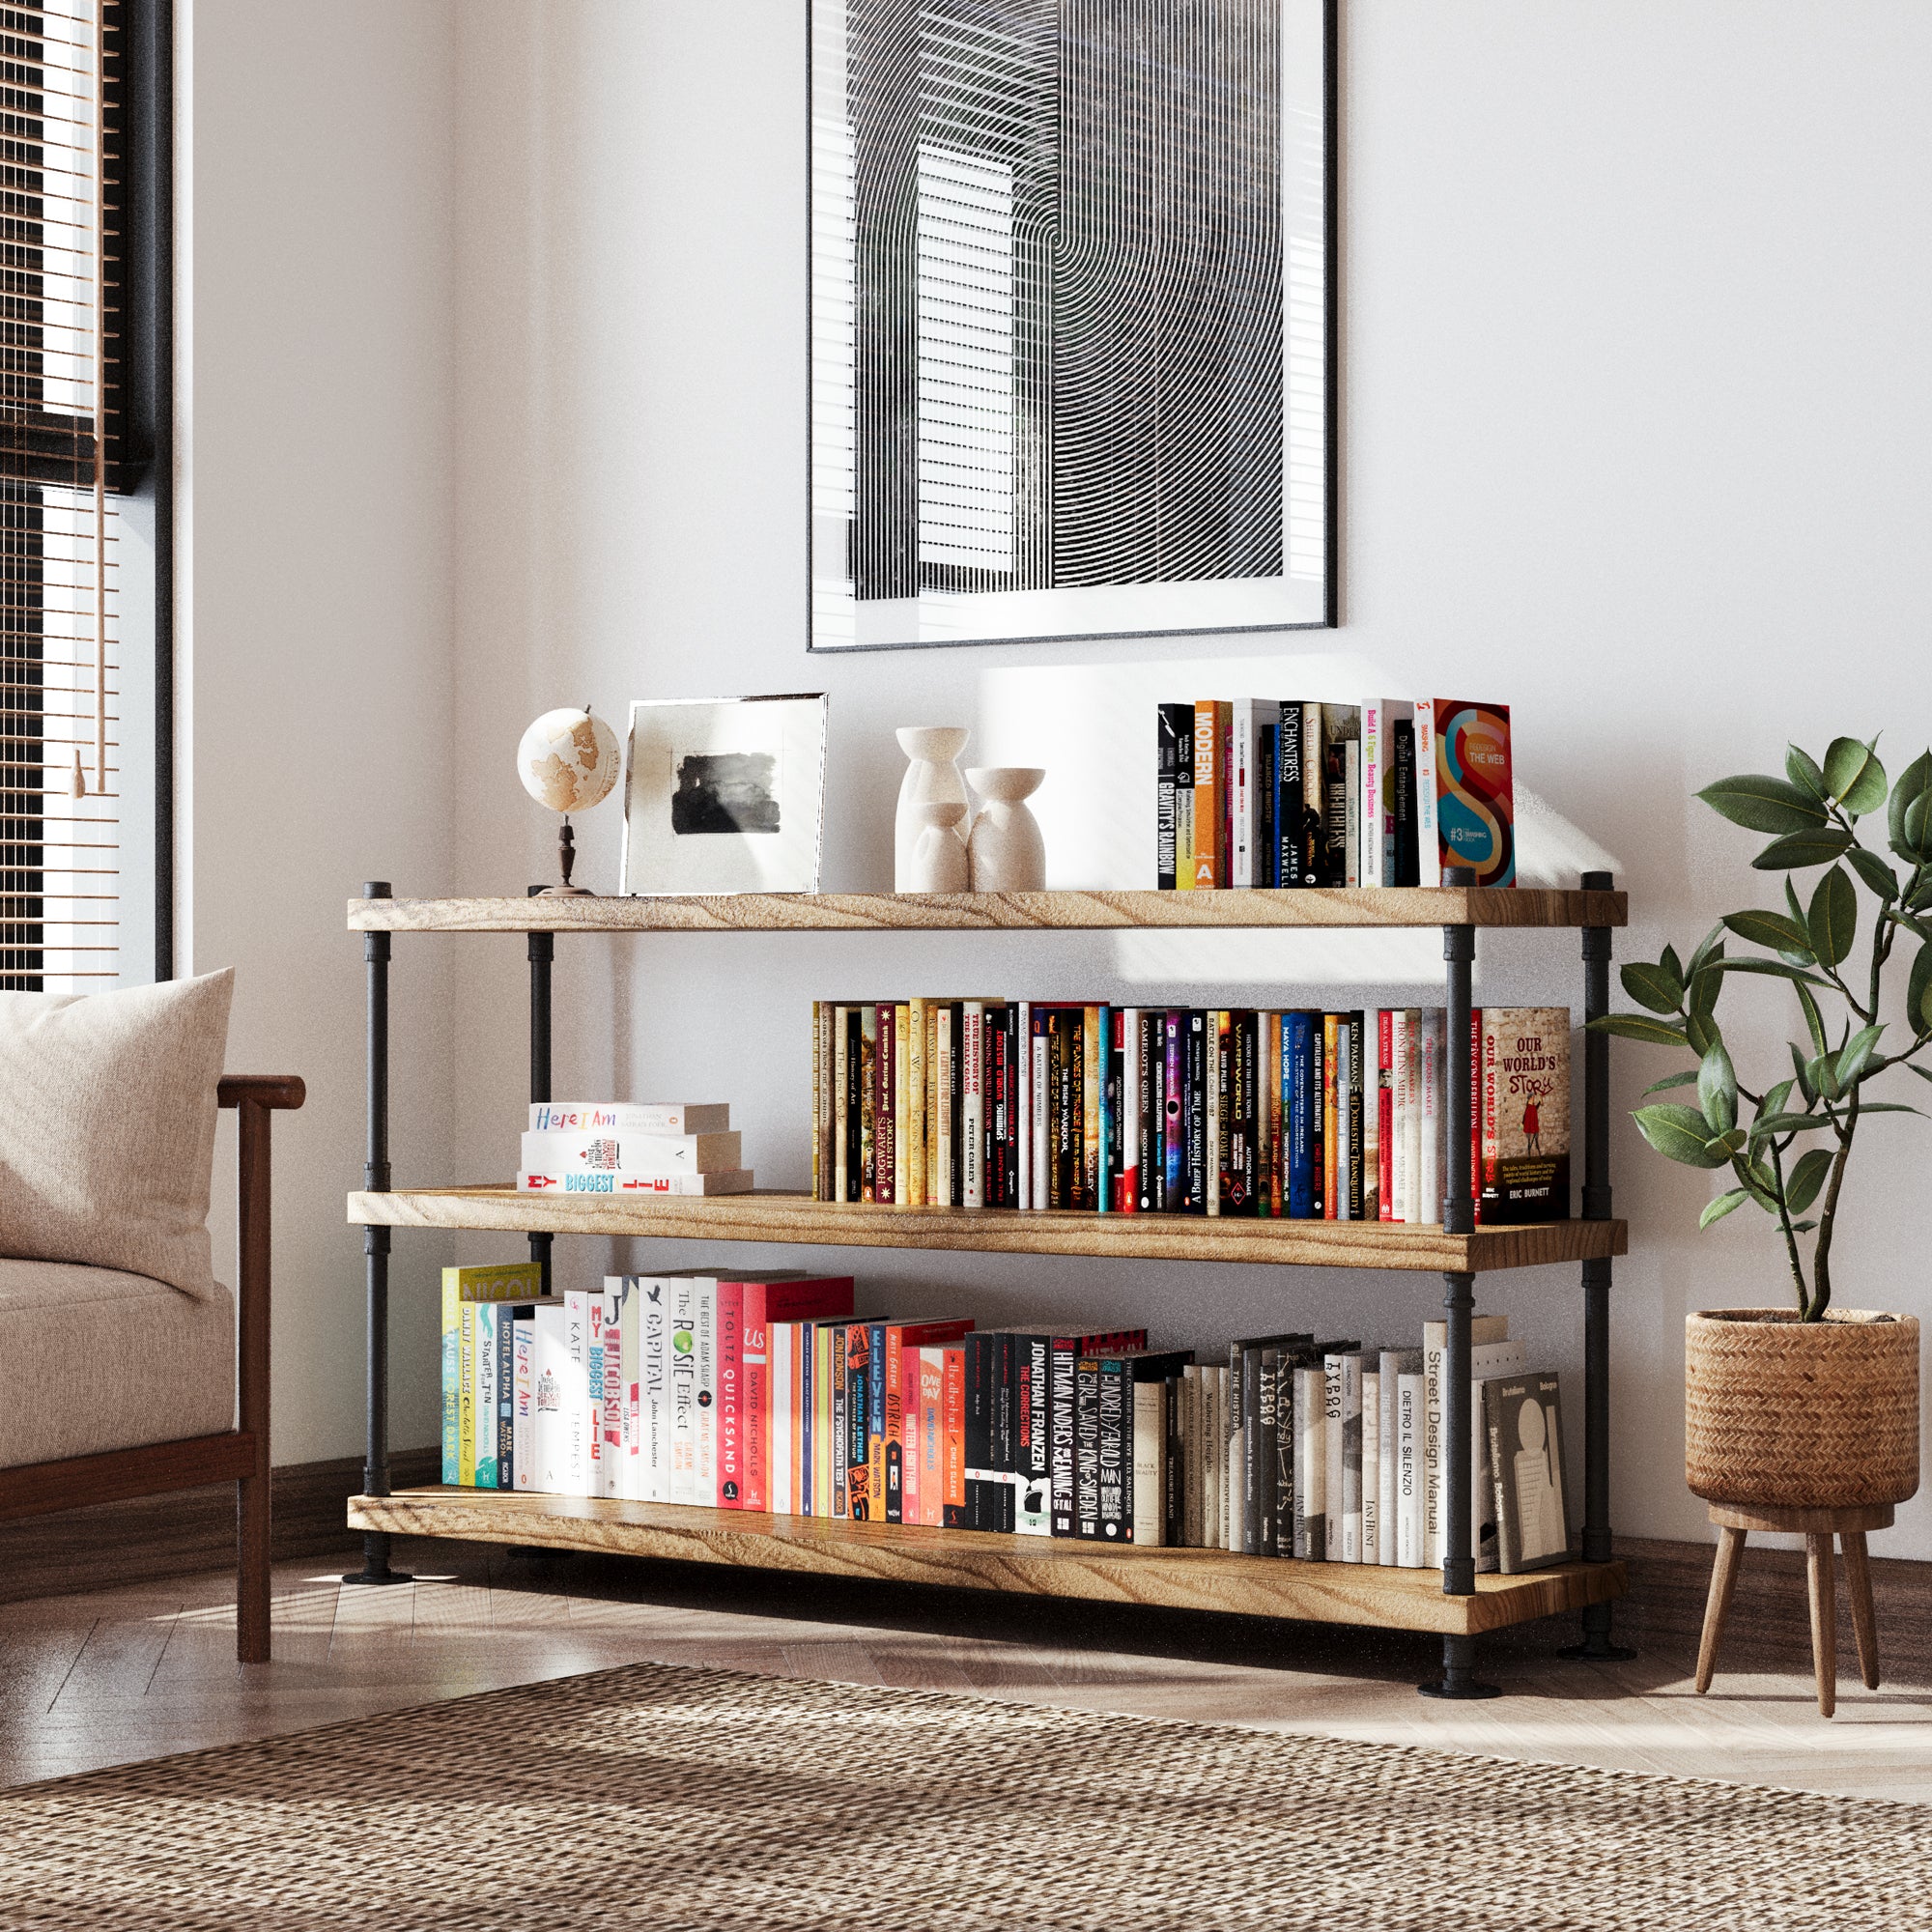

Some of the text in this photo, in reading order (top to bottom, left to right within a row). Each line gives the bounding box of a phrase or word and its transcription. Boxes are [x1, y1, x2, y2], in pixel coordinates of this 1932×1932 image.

[1195, 712, 1212, 785] MODERN
[1284, 707, 1299, 782] ENCHANTRESS
[1470, 753, 1505, 765] THE WEB
[1397, 735, 1408, 821] Digital Entanglement
[1158, 781, 1175, 875] GRAVITY'S RAINBOW
[1281, 837, 1290, 888] MAXWELL
[1350, 1022, 1359, 1083] KEN PAKMAN
[1503, 1056, 1555, 1072] WORLD'S
[1518, 1037, 1542, 1052] OUR
[836, 1072, 844, 1090] Epic
[850, 1082, 856, 1091] of
[537, 1107, 578, 1129] Here
[579, 1112, 590, 1129] I
[591, 1110, 616, 1127] Am
[836, 1092, 844, 1123] Cycle
[1219, 1094, 1228, 1122] SIEGE
[1299, 1116, 1304, 1124] IN
[1486, 1035, 1497, 1183] OUR WORLD'S STORY
[877, 1117, 886, 1184] HOGWARTS
[1192, 1090, 1202, 1204] A BRIEF HISTORY OF TIME
[1219, 1130, 1228, 1159] ROME
[1350, 1102, 1360, 1208] DOMESTIC TRANQUILITY
[528, 1174, 669, 1192] MY BIGGEST LIE
[1510, 1187, 1549, 1199] ERIC BURNETT
[591, 1306, 602, 1338] MY
[678, 1291, 690, 1316] The
[463, 1307, 471, 1394] DANNY WALLACE
[501, 1321, 511, 1399] HOTEL ALPHA
[515, 1329, 533, 1376] Here
[571, 1321, 580, 1364] KATE
[724, 1310, 735, 1363] TOLTZ
[835, 1334, 845, 1390] JON RONSON
[482, 1383, 492, 1404] TEN
[516, 1377, 530, 1388] I
[589, 1347, 604, 1401] BIGGEST
[871, 1330, 882, 1433] ELEVEN
[922, 1375, 941, 1387] ONE
[1052, 1351, 1073, 1399] HITMAN
[1331, 1362, 1341, 1419] TYPOG
[445, 1377, 455, 1461] FOREST DARK
[518, 1389, 532, 1417] Am
[677, 1382, 691, 1430] Effect
[724, 1369, 735, 1474] QUICKSAND
[750, 1372, 758, 1477] DAVID NICHOLLS
[887, 1393, 900, 1436] OSTRICH
[1020, 1365, 1030, 1447] THE CORRECTIONS
[1032, 1342, 1046, 1471] JONATHAN FRANZEN
[1052, 1401, 1073, 1445] ANDERS
[1078, 1406, 1096, 1440] SAVED
[463, 1397, 471, 1462] Charlotte Street
[590, 1408, 601, 1461] LIE
[835, 1398, 845, 1487] THE PSYCHOPATH TEST
[926, 1407, 935, 1470] DAVID NICHOLLS
[1205, 1392, 1213, 1474] Wuthering Heights
[1403, 1390, 1411, 1496] DIETRO IL SILENZIO
[1425, 1350, 1440, 1535] Street Design Manual
[872, 1442, 881, 1499] MARK WATSON
[1079, 1448, 1096, 1474] KING
[1101, 1469, 1121, 1485] MAN
[1079, 1478, 1097, 1520] SWEDEN
[1366, 1500, 1376, 1548] IAN HUNT
